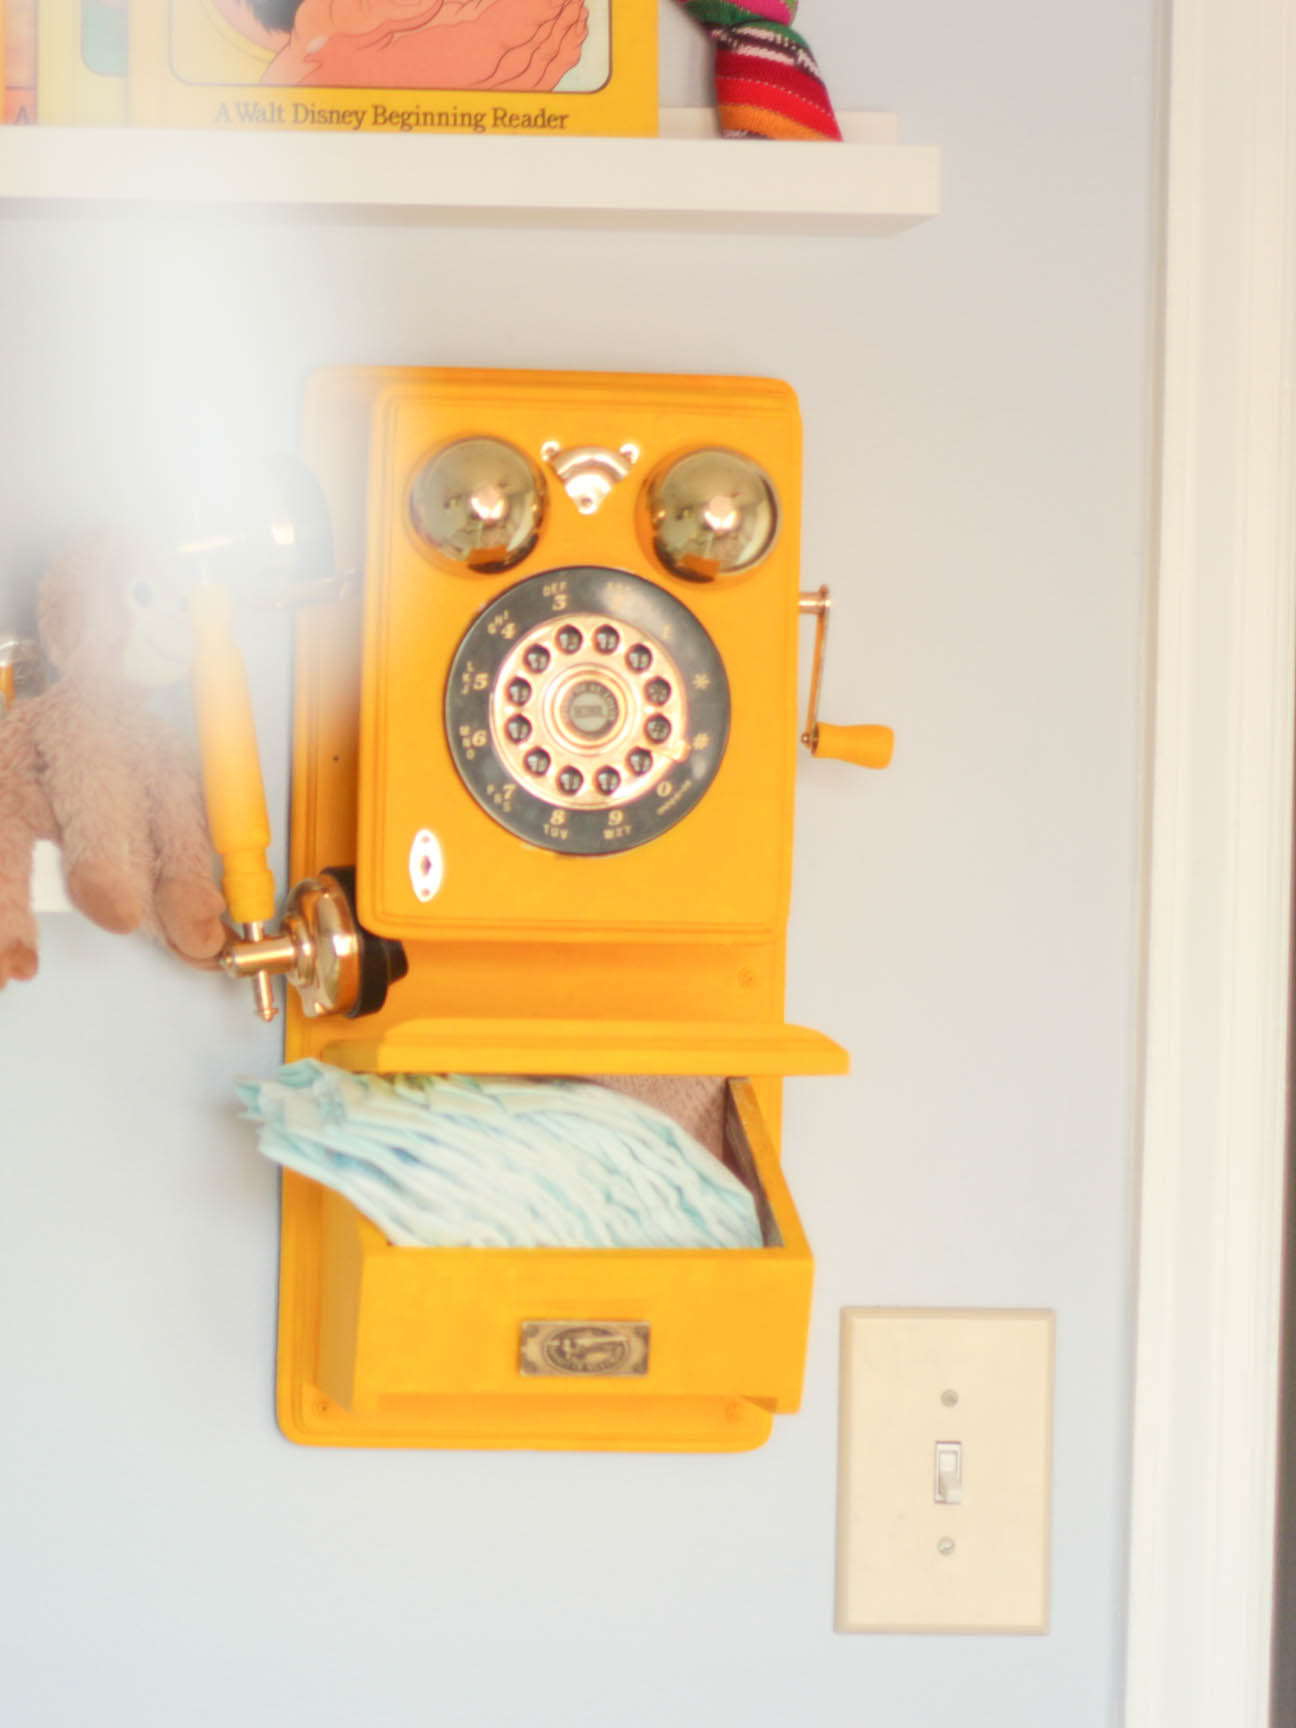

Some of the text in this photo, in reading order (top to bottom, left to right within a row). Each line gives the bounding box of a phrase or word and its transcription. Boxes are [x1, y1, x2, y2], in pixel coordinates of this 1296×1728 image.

[215, 102, 569, 133] A Walt Disney Beginning Reader
[501, 622, 516, 639] 4
[472, 672, 489, 690] 5
[471, 729, 488, 747] 6
[503, 783, 517, 799] 7
[657, 781, 673, 797] 0
[550, 808, 567, 826] 8
[608, 809, 624, 826] 9
